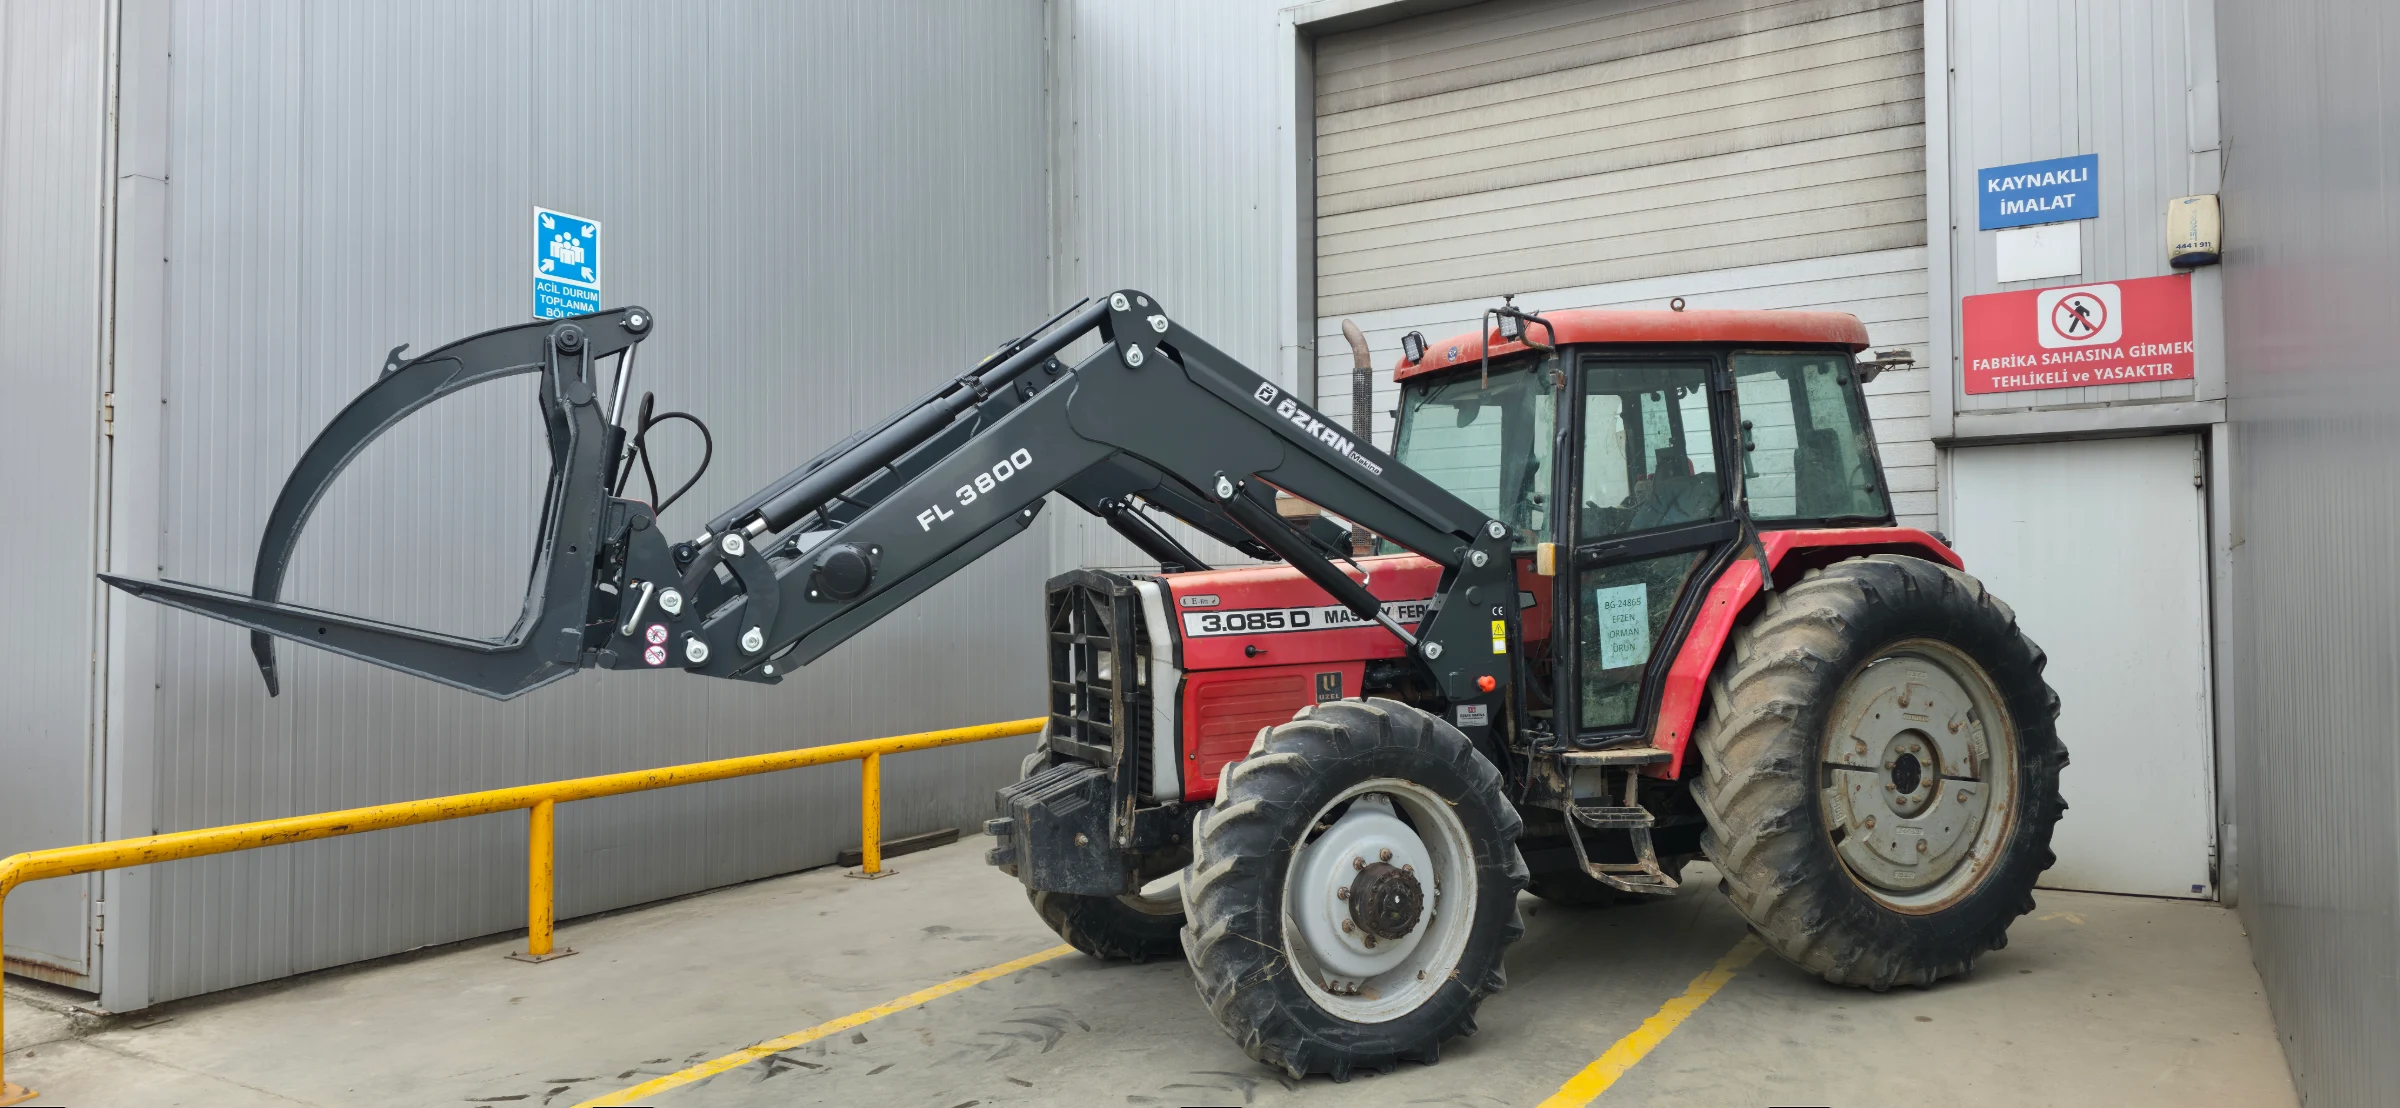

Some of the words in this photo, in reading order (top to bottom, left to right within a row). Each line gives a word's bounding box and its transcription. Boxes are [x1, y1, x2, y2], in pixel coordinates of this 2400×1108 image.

[1988, 167, 2088, 193] KAYNAKLI
[2000, 193, 2076, 216] İMALAT
[537, 282, 560, 294] ACİL
[563, 287, 598, 301] DURUM
[540, 294, 595, 312] TOPLANMA
[1972, 353, 2038, 371] FABRİKA
[2041, 346, 2125, 366] SAHASINA
[2128, 341, 2194, 358] GİRMEK
[1991, 368, 2068, 389] TEHLİKELİ
[2072, 371, 2091, 382] ve
[2093, 362, 2174, 380] YASAKTIR
[1276, 397, 1355, 458] ÖZKAN
[916, 504, 955, 532] FL
[955, 447, 1033, 506] 3800
[1201, 611, 1286, 633] 3.085
[1289, 610, 1311, 628] D
[1492, 606, 1504, 616] CE
[1609, 628, 1639, 638] ORMAN
